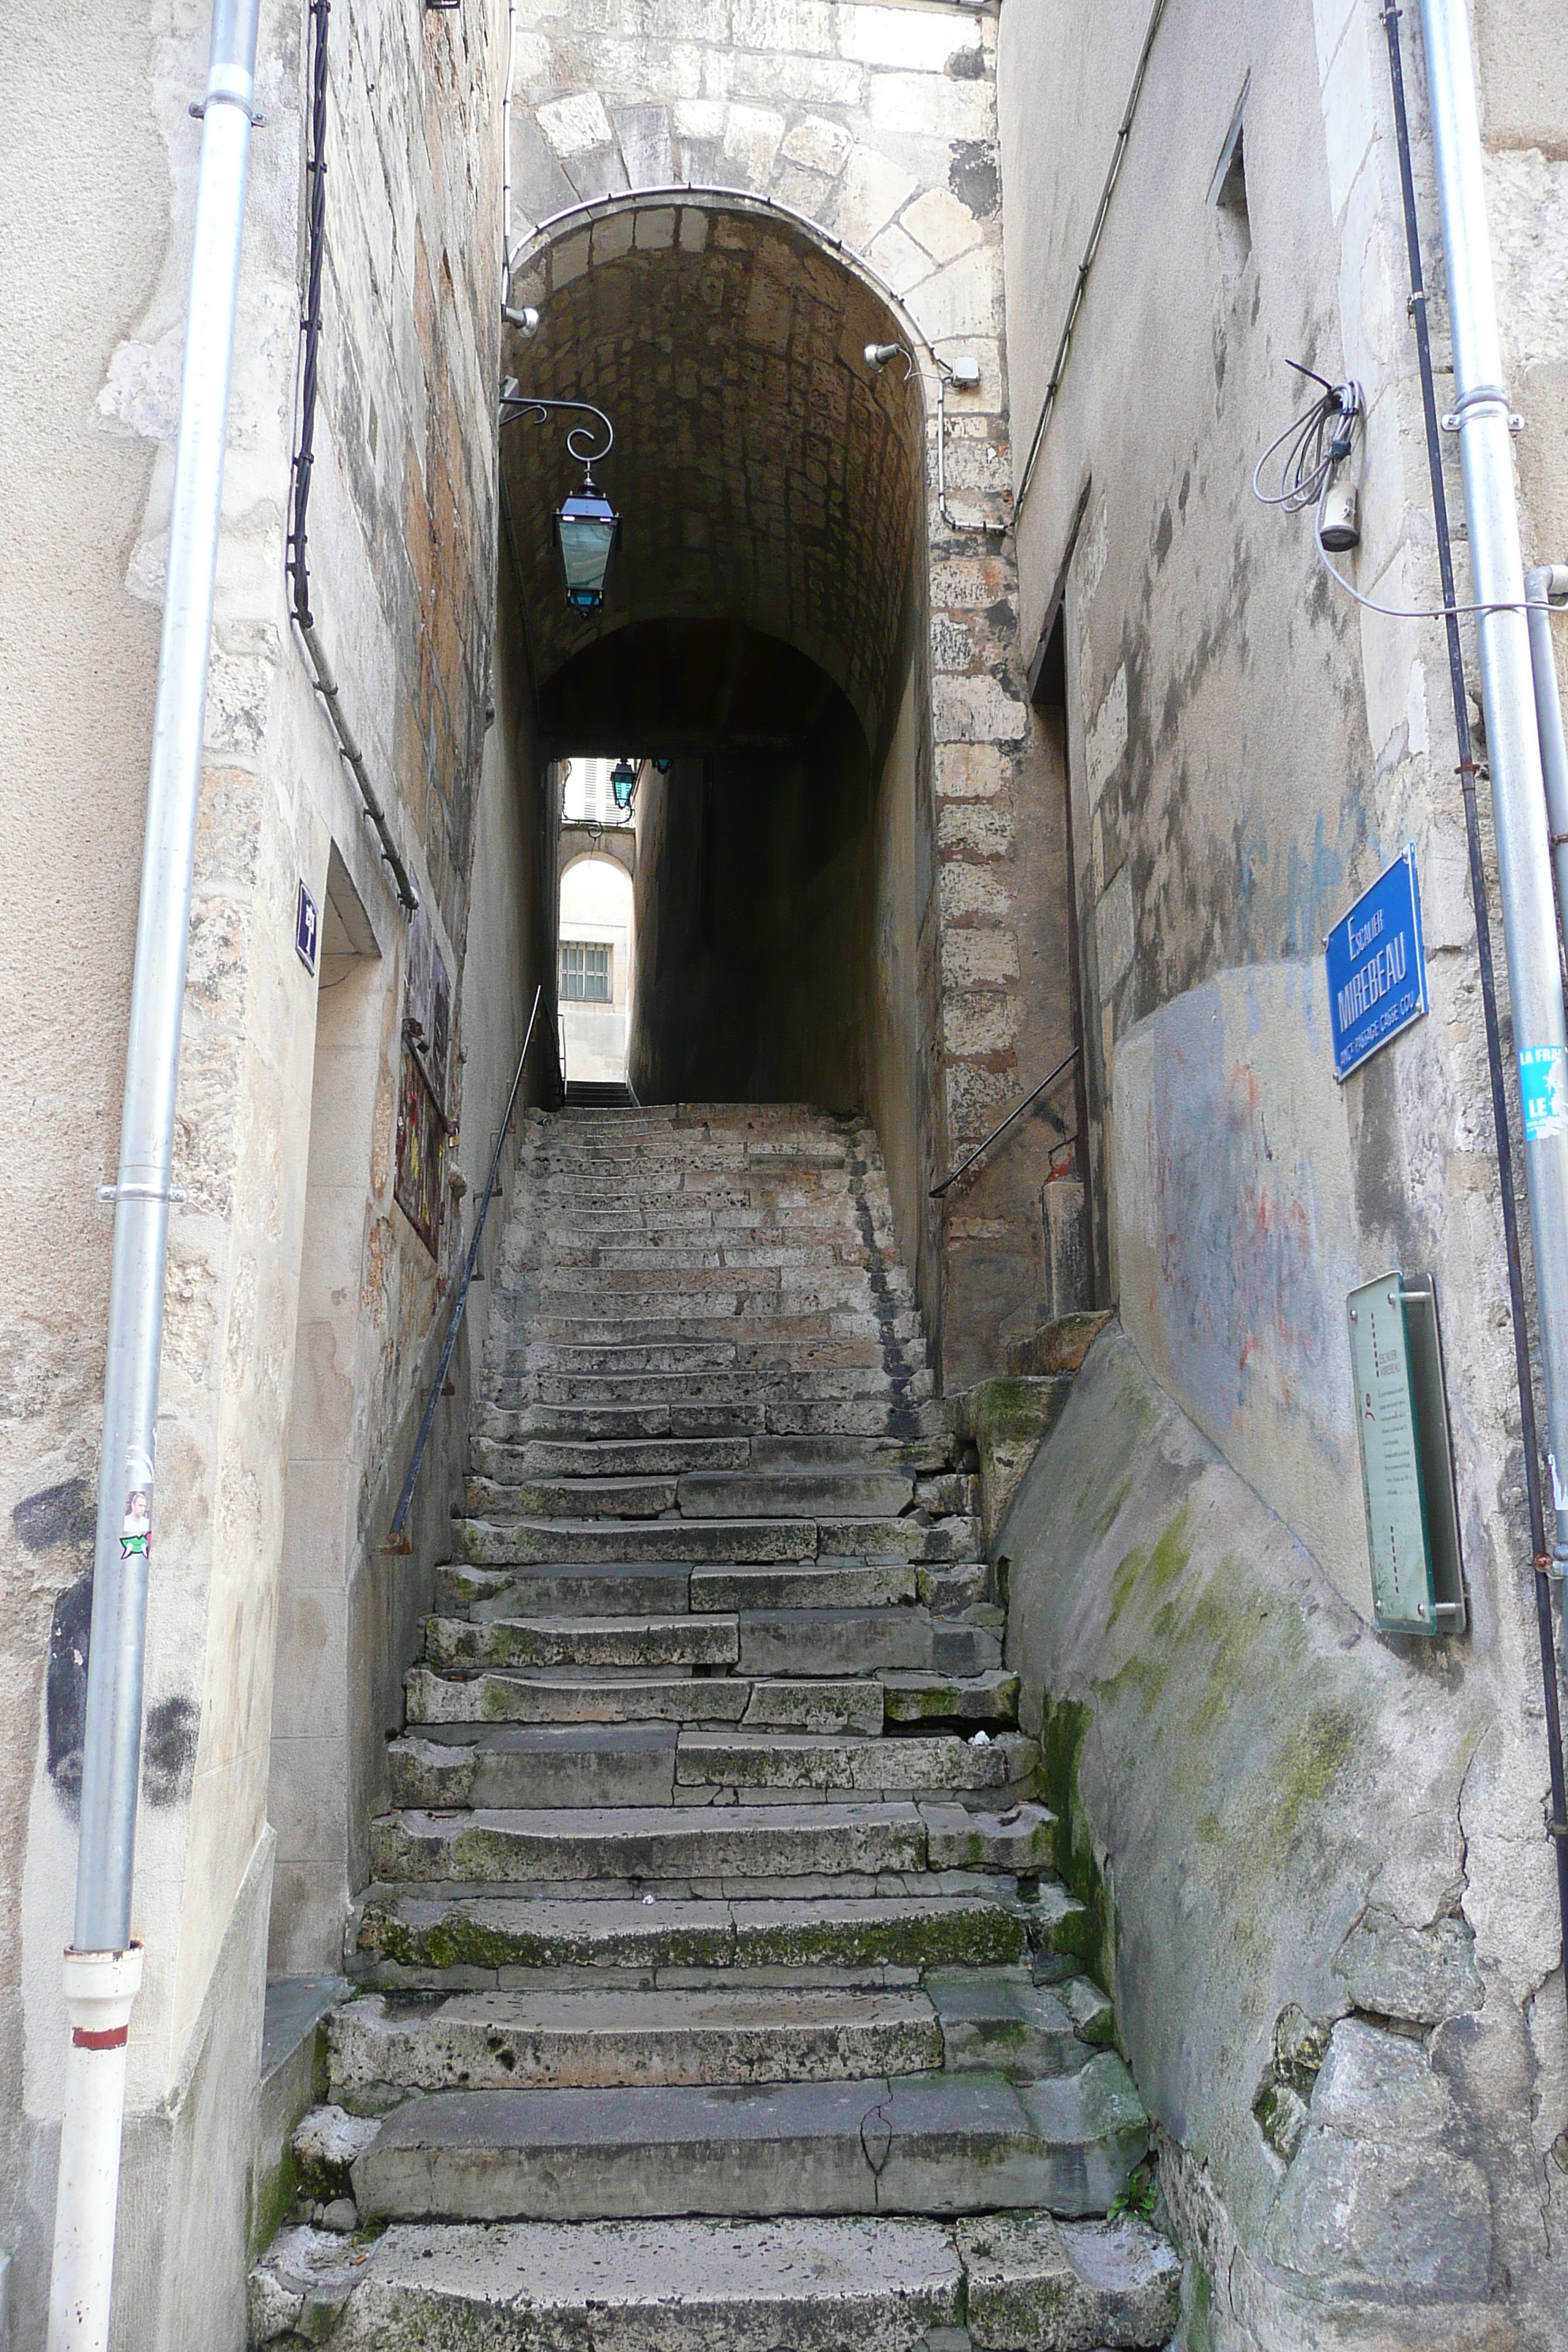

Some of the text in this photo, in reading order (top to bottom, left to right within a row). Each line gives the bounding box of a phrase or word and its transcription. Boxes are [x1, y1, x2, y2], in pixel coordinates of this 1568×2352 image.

[1348, 909, 1384, 962] ESCALIER
[1338, 931, 1406, 1033] MIREBEAU
[1400, 990, 1414, 1015] COU
[1520, 1050, 1534, 1066] LA
[1529, 1097, 1548, 1118] LE
